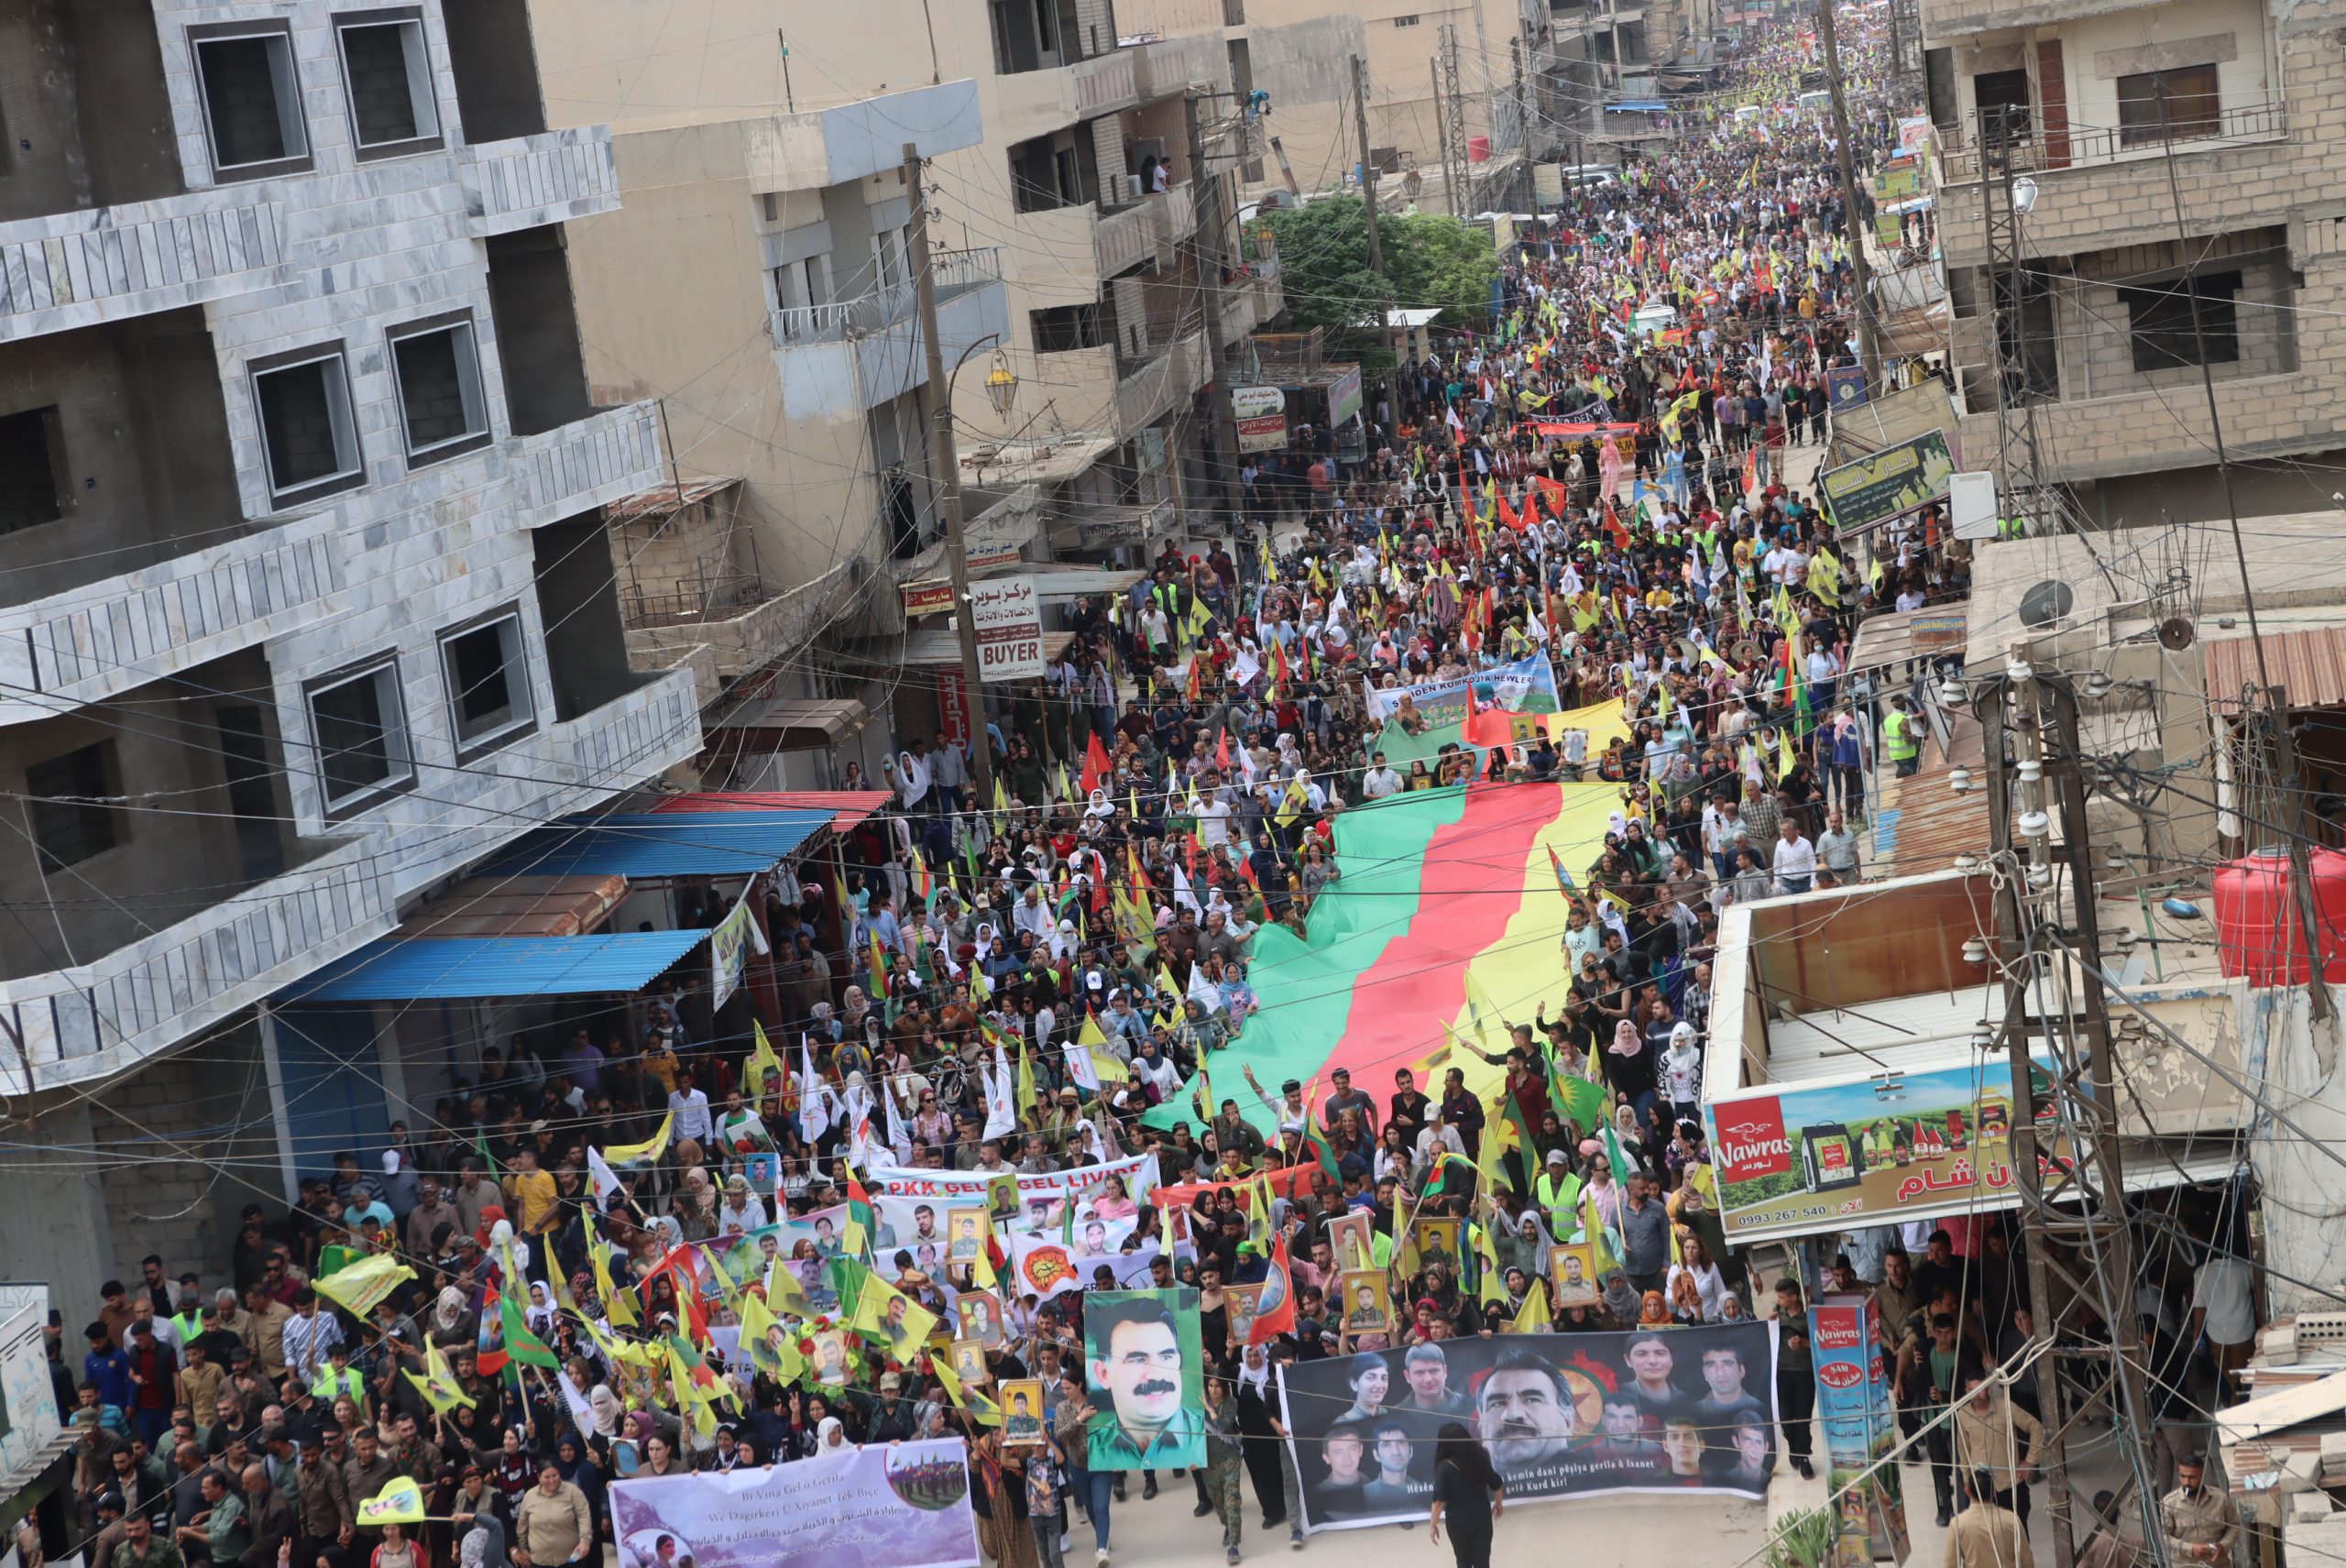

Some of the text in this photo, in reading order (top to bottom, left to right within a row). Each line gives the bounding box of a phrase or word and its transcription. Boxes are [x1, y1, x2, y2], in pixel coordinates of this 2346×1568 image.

[974, 583, 1031, 607] مركز بوير
[1004, 607, 1034, 619] للاتصالات
[984, 642, 1038, 665] BUYER
[1714, 1136, 1793, 1170] Nawras
[1741, 1158, 1772, 1171] نورس
[889, 1180, 937, 1196] PKK
[945, 1180, 987, 1193] GEL
[1016, 1176, 1062, 1190] GEL
[1898, 1157, 1978, 1202] شام
[1738, 1213, 1770, 1225] 0993
[1774, 1209, 1798, 1222] 267
[1803, 1205, 1826, 1217] 540
[1814, 1329, 1861, 1343] Nawras
[784, 1483, 802, 1497] Gel
[1527, 1478, 1549, 1493] Kurd
